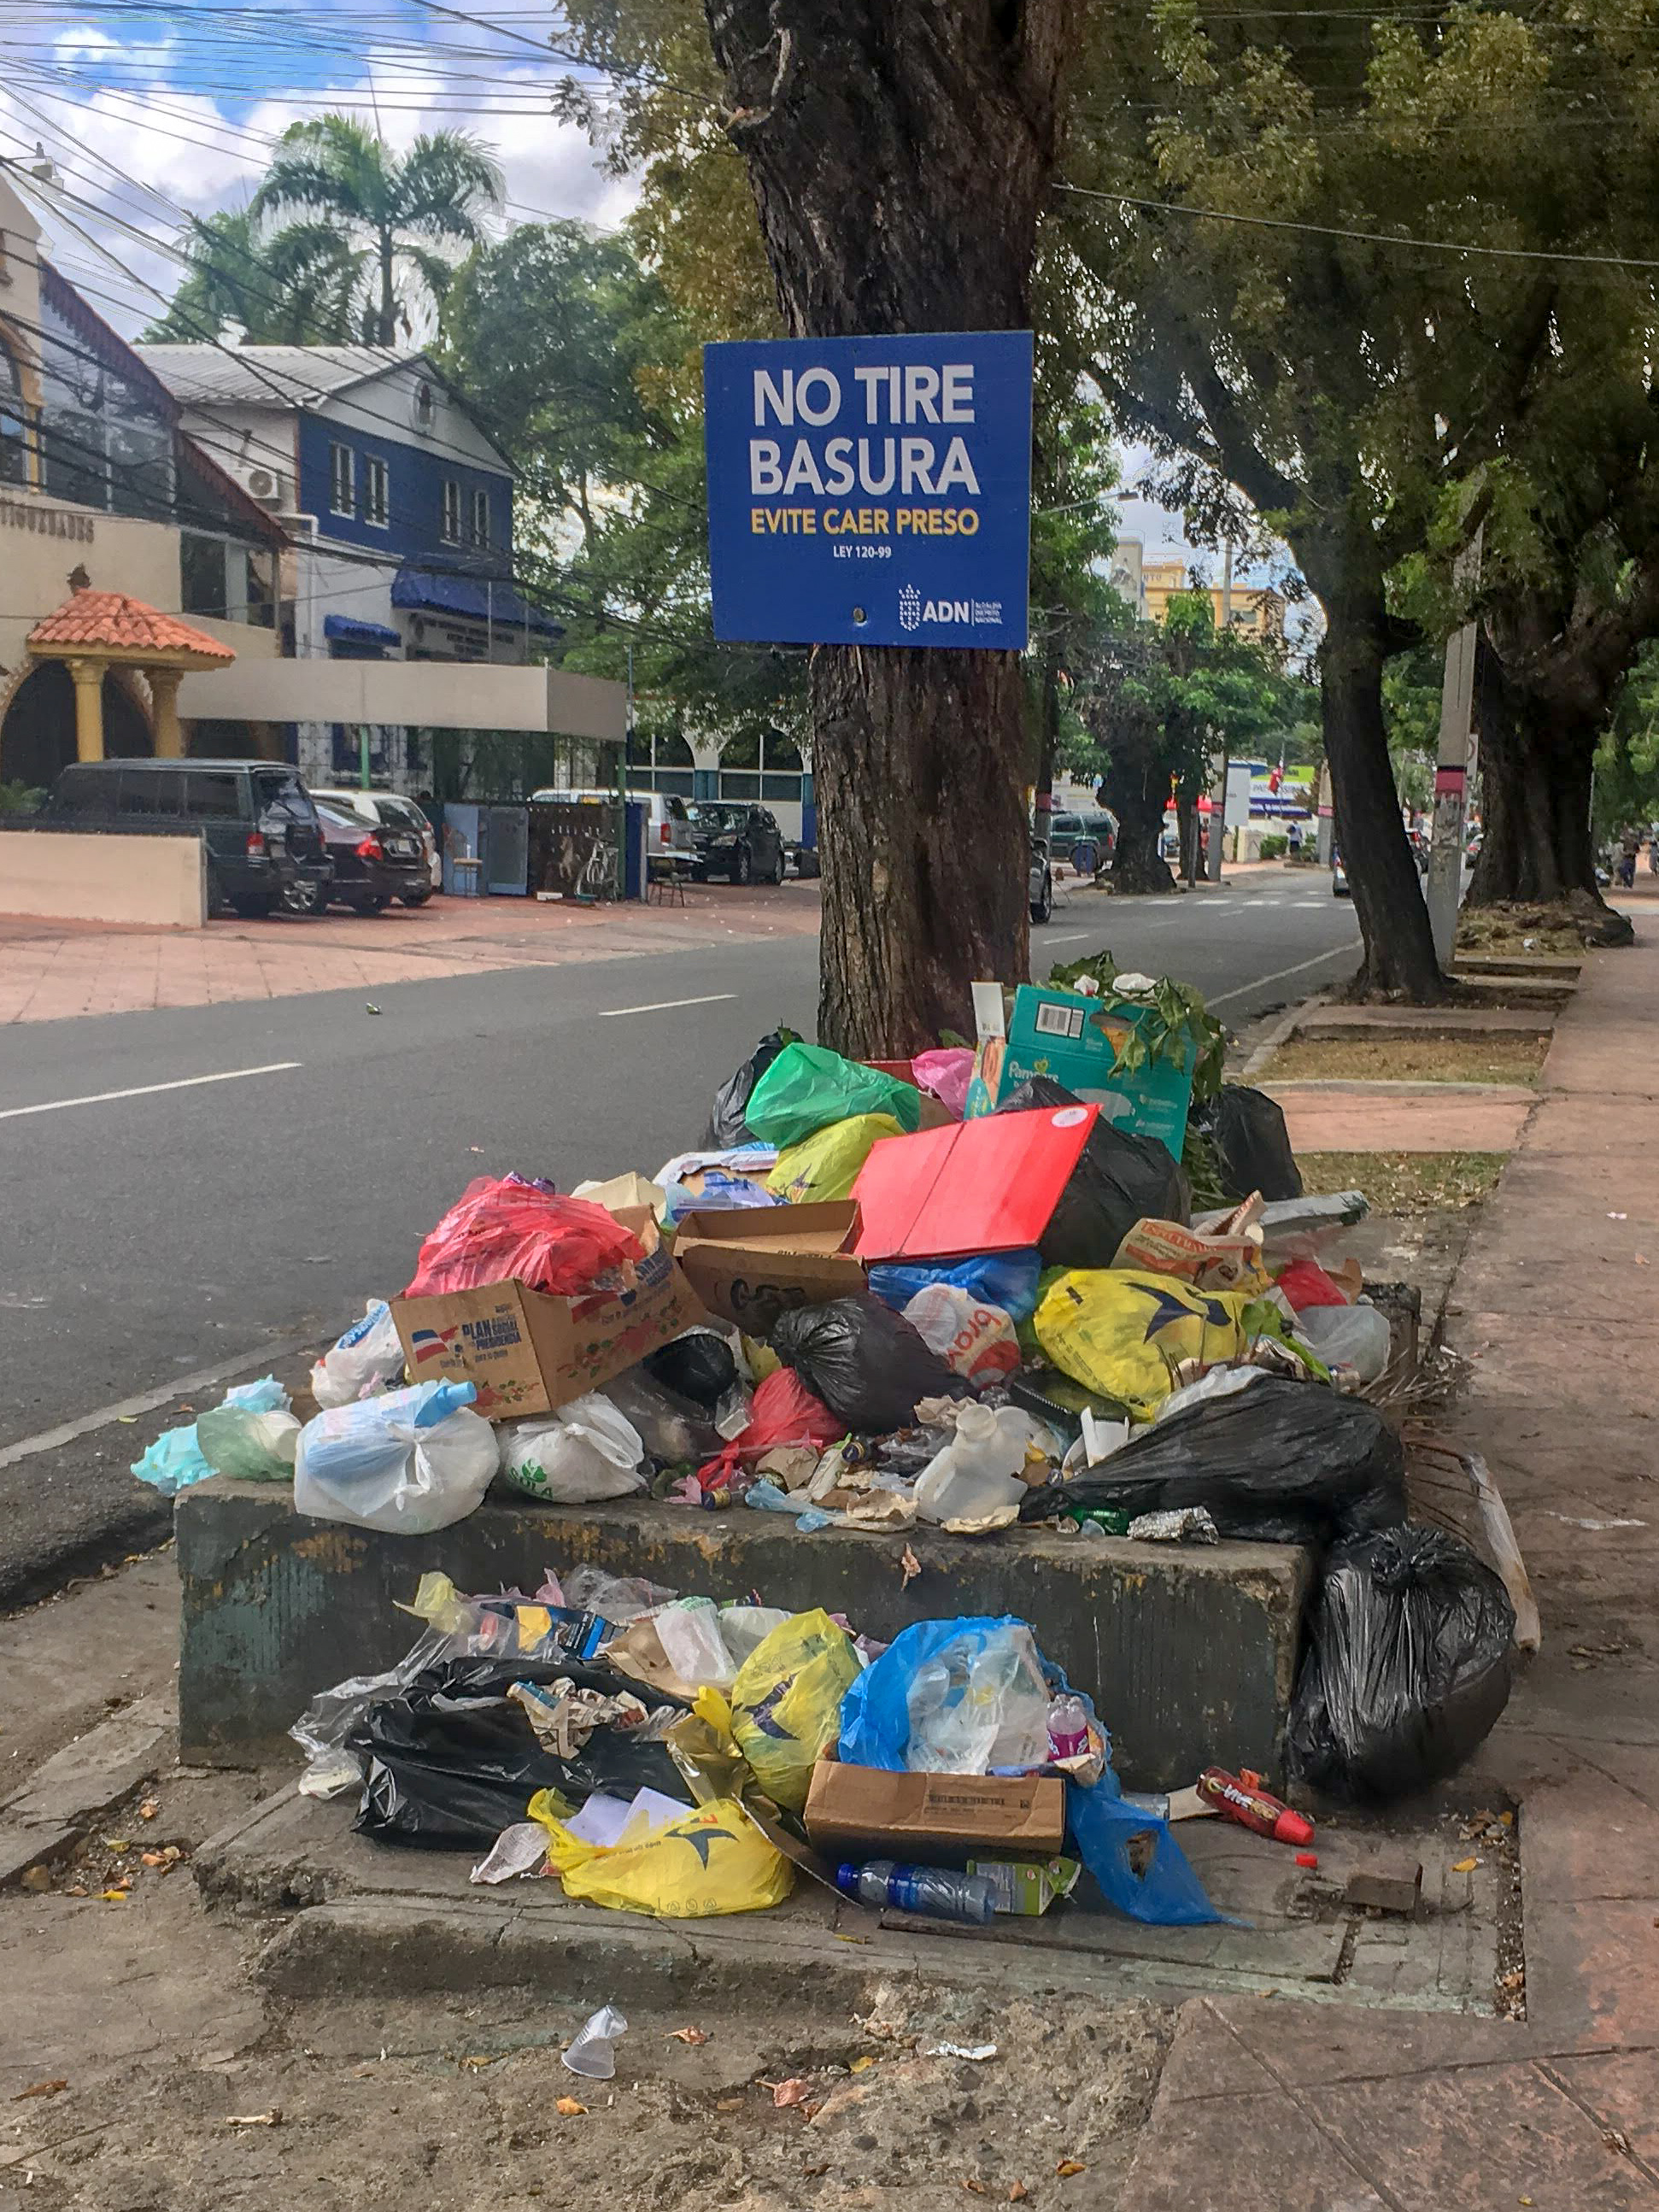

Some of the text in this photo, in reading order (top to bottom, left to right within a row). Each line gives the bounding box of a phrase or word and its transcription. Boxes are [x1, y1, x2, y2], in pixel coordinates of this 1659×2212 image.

[753, 364, 976, 427] NO TIRE
[749, 436, 982, 496] BASURA
[751, 507, 980, 537] EVITE CAER PRESO
[833, 545, 892, 559] LEY 120-99
[922, 600, 970, 624] ADN
[1009, 1060, 1059, 1083] Pamrs
[461, 1318, 493, 1341] PLAN
[945, 1309, 1002, 1373] brav
